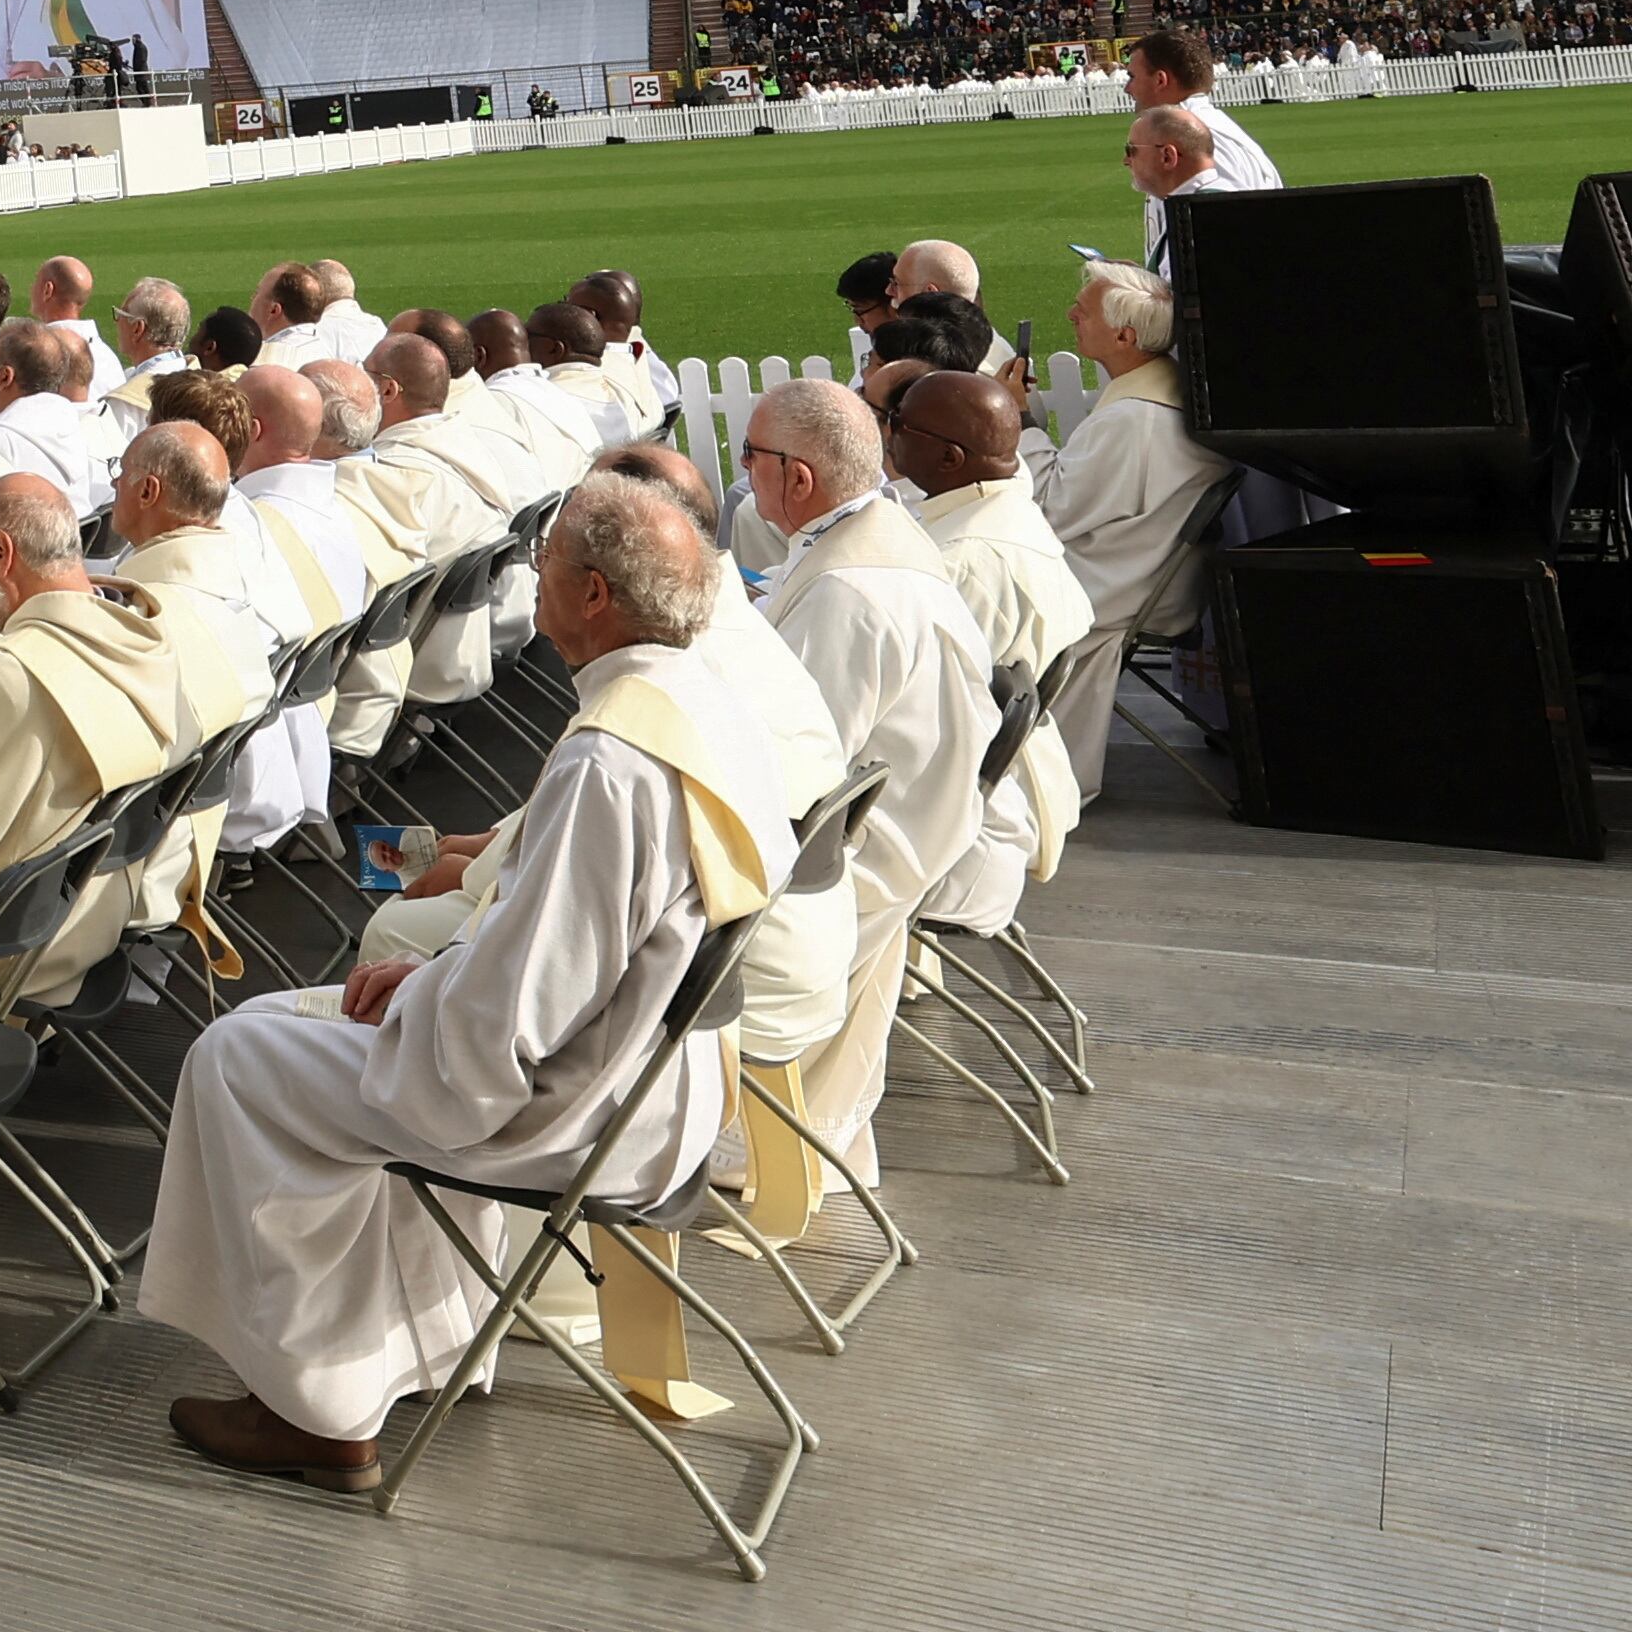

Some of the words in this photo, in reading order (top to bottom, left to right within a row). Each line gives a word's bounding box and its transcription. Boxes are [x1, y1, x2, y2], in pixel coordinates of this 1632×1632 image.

[633, 81, 659, 97] 25
[723, 75, 749, 91] 24
[237, 109, 262, 125] 26
